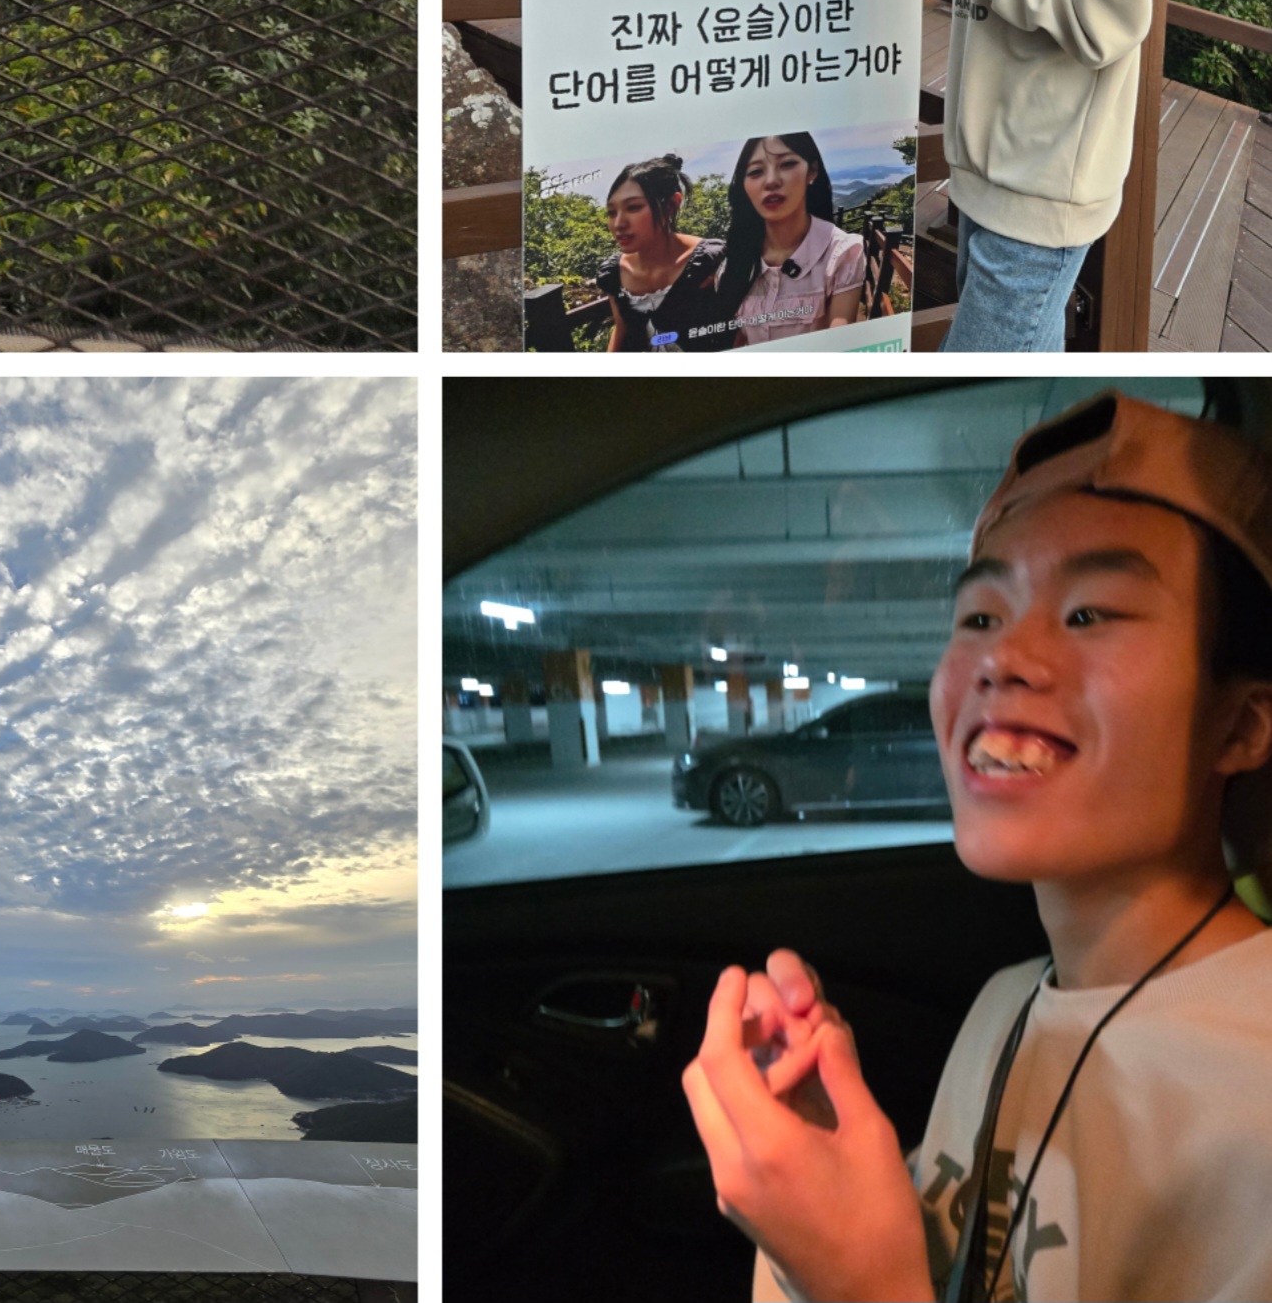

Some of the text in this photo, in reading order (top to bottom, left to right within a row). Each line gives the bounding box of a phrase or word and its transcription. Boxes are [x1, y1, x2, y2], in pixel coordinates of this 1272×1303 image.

[611, 11, 683, 51] 진짜
[549, 42, 902, 110] 단어를 어떻게 아는거야
